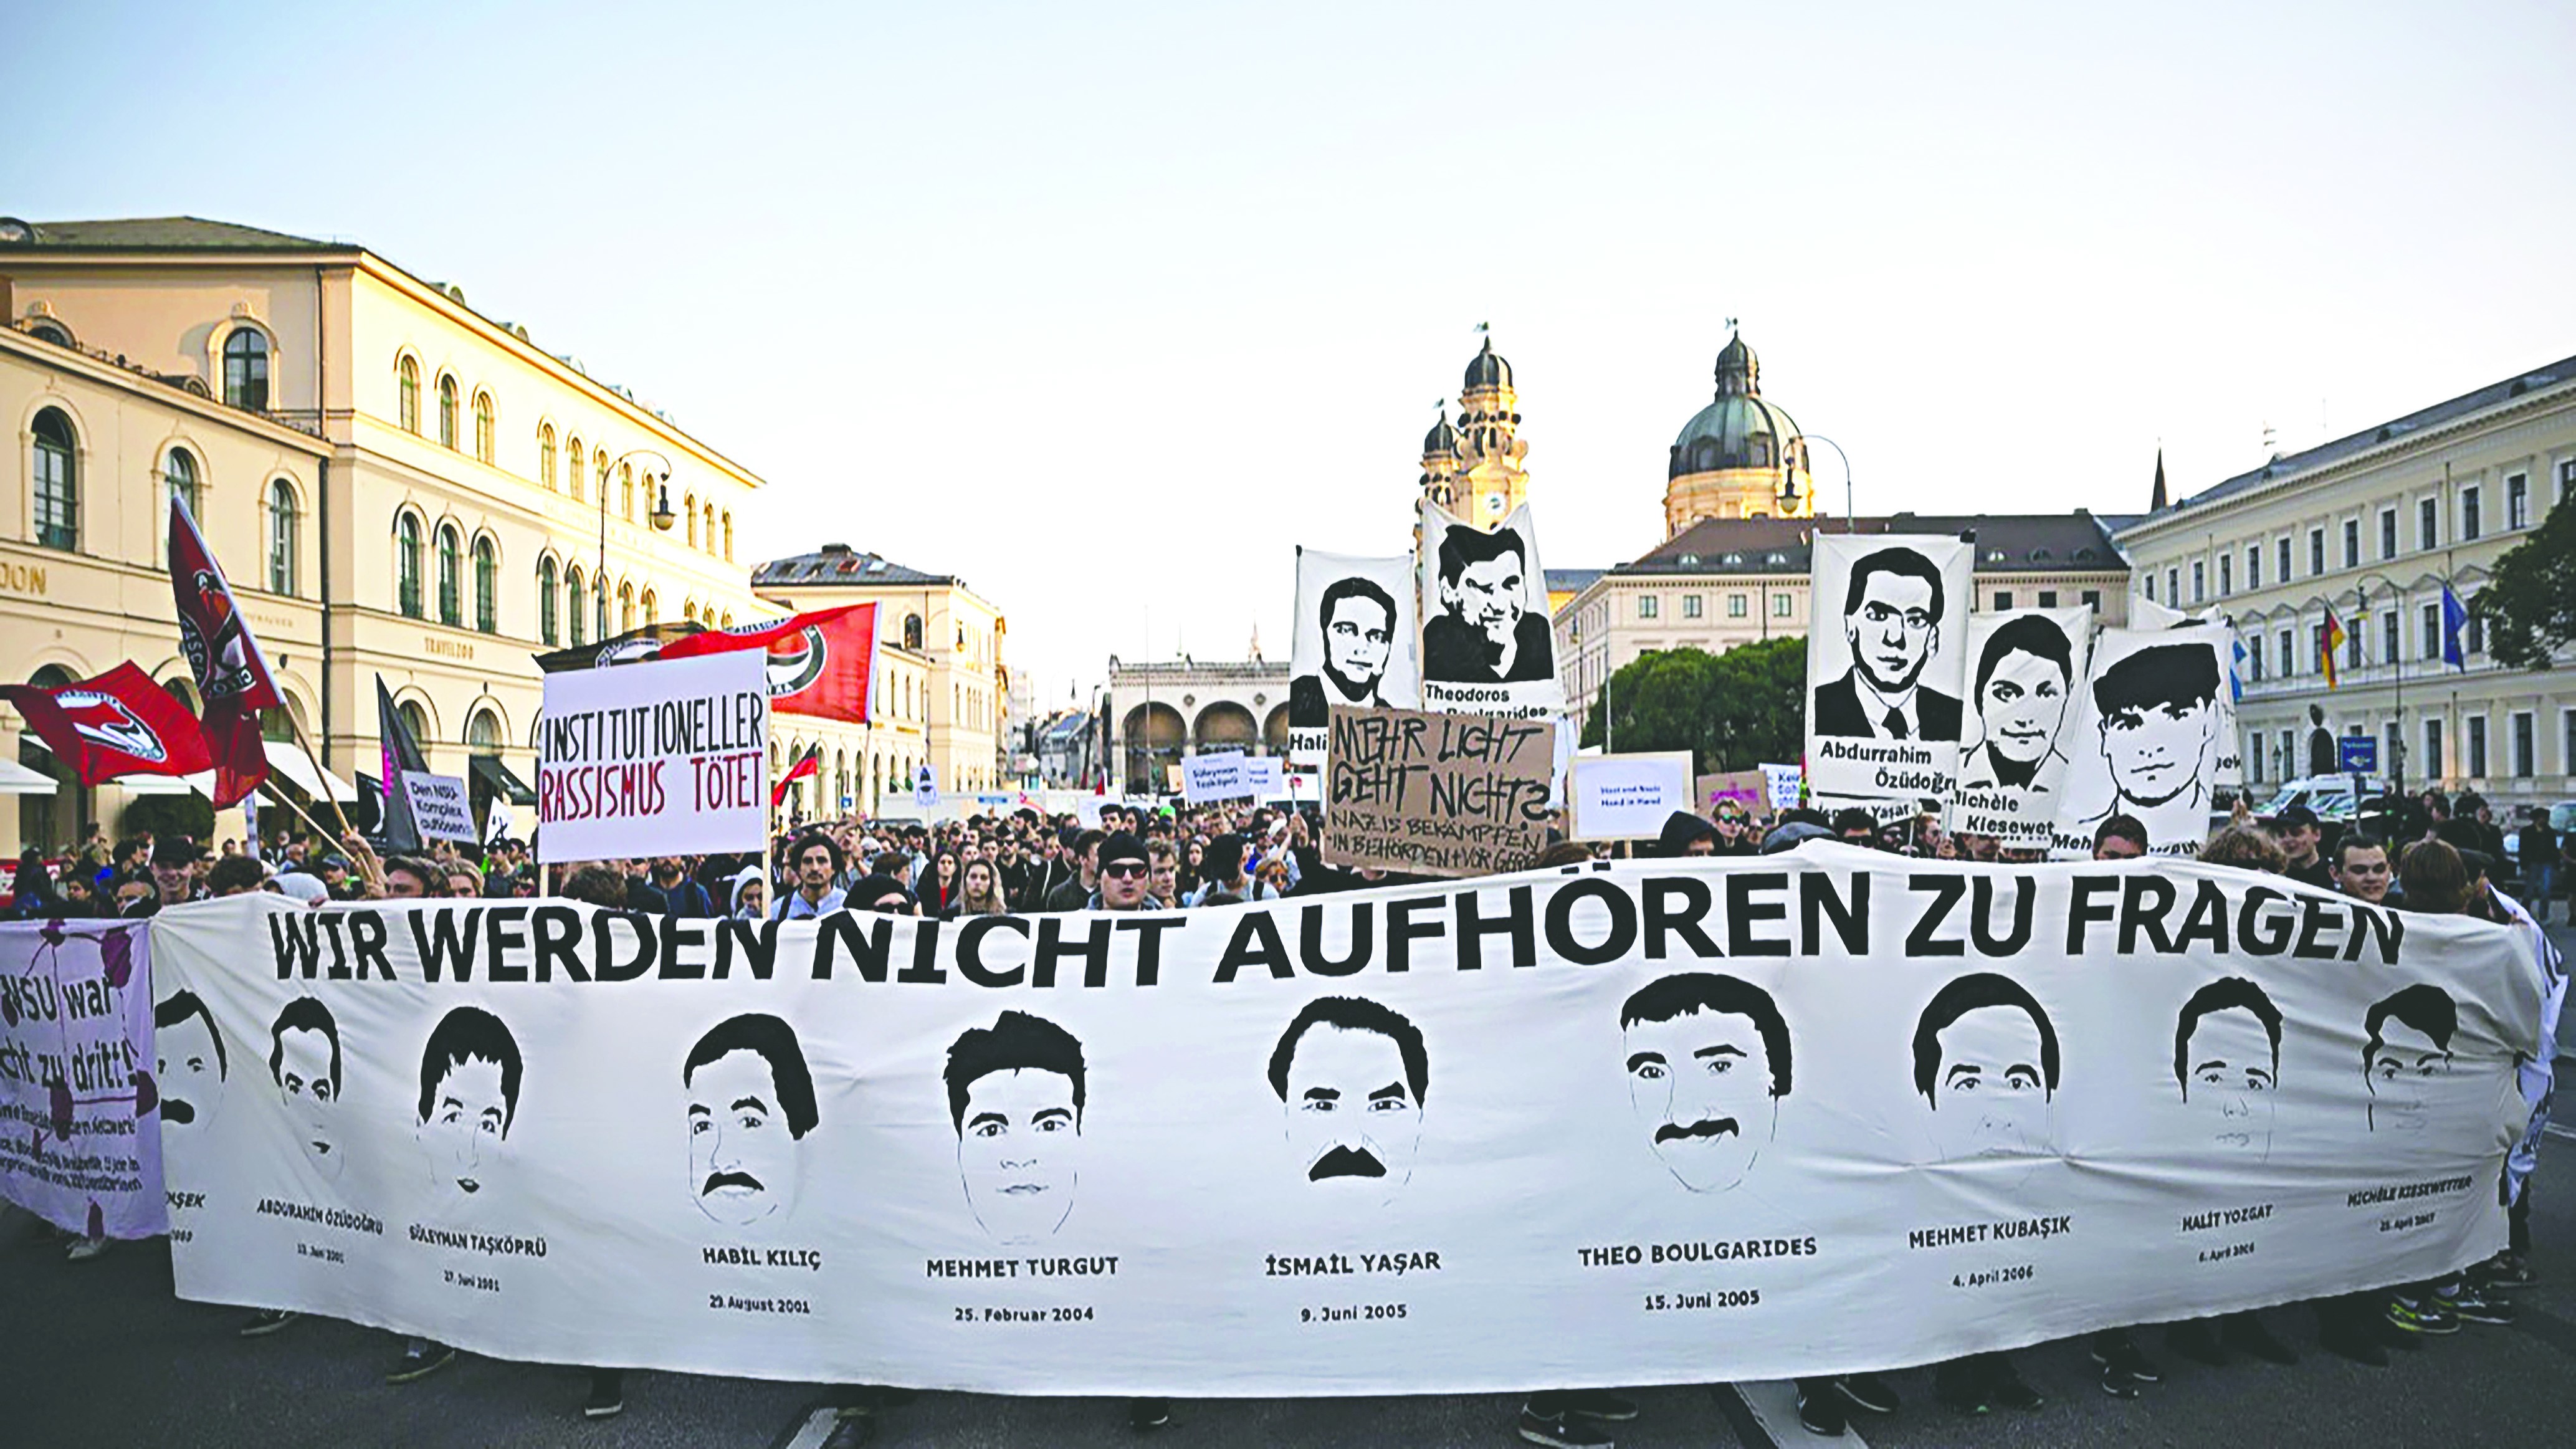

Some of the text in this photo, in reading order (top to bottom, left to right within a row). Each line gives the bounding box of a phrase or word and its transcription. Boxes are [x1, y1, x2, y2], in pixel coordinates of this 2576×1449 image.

[1426, 684, 1510, 702] Theodoros
[545, 692, 763, 763] INSTITUTIONELLER
[1333, 714, 1543, 765] MEHR LICHT
[1820, 741, 1932, 764] Abdurrahim
[541, 752, 763, 823] RASSISMUS TÖTET
[1332, 762, 1429, 812] GEHT
[1331, 810, 1400, 833] NAZIS
[268, 861, 2405, 988] WIR WERDEN NICHT AUFHÖREN ZU FRAGEN
[62, 977, 112, 1020] war
[37, 1054, 66, 1089] zu
[72, 1040, 137, 1092] dritt!
[2223, 1203, 2274, 1224] YOZGAT
[1909, 1215, 2071, 1249] MEHMET KUBAŞIK
[470, 1234, 547, 1257] TAŞKÖPRÜ
[1578, 1236, 1818, 1266] THEO BOULGARIDES
[703, 1246, 821, 1271] HABİL KILIÇ
[927, 1256, 1119, 1278] MEHMET TURGUT
[1265, 1251, 1441, 1276] İSMAİL YAŞAR
[1952, 1265, 2033, 1288] 4. April 2006
[727, 1296, 775, 1312] August
[778, 1299, 810, 1314] 2001
[1645, 1289, 1760, 1311] 15. Juni 2005
[955, 1306, 1094, 1322] 25. Februar 2004
[1300, 1304, 1408, 1323] 9. Juni 2005
